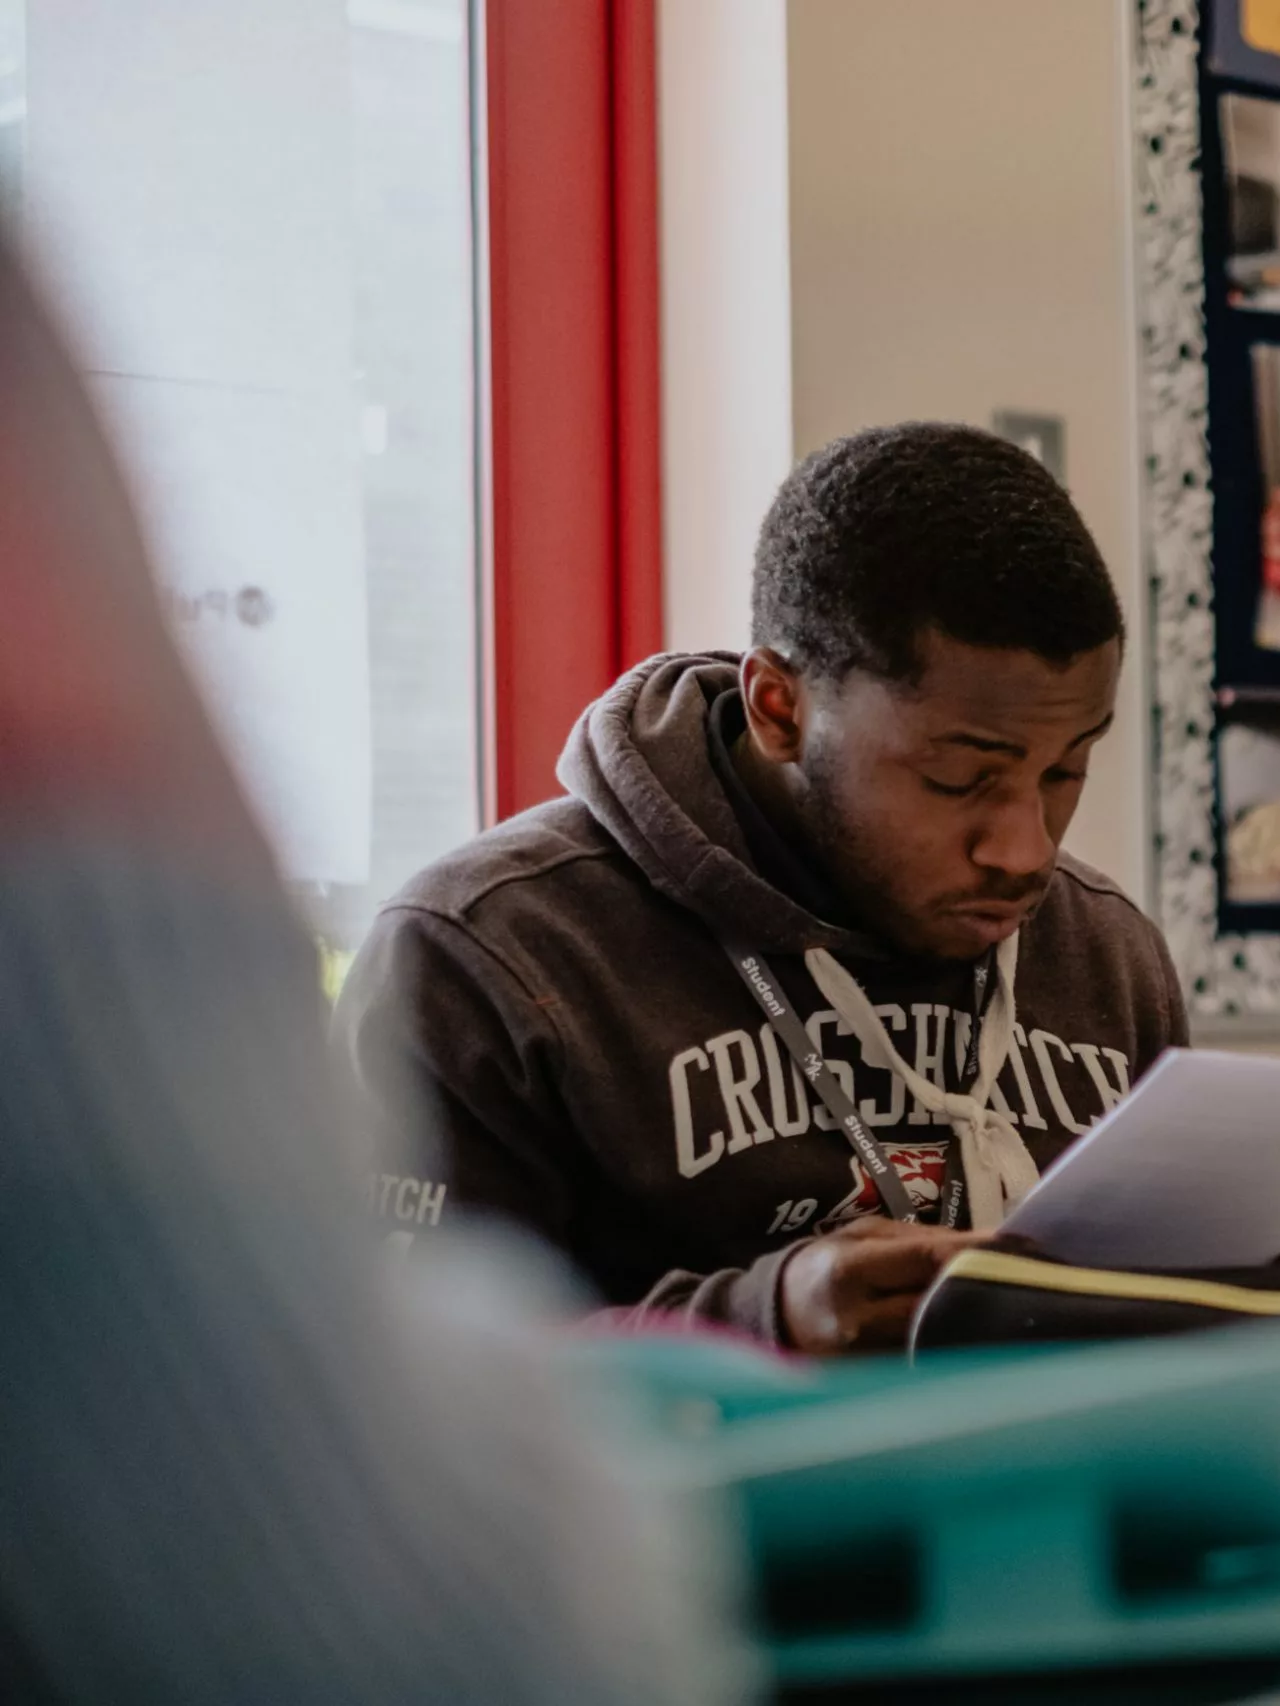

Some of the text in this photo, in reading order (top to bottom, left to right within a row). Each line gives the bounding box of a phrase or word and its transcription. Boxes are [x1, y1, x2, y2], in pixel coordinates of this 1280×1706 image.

[741, 956, 786, 1017] Student
[844, 1115, 888, 1176] Student
[766, 1198, 818, 1236] 19
[948, 1179, 964, 1229] udent
